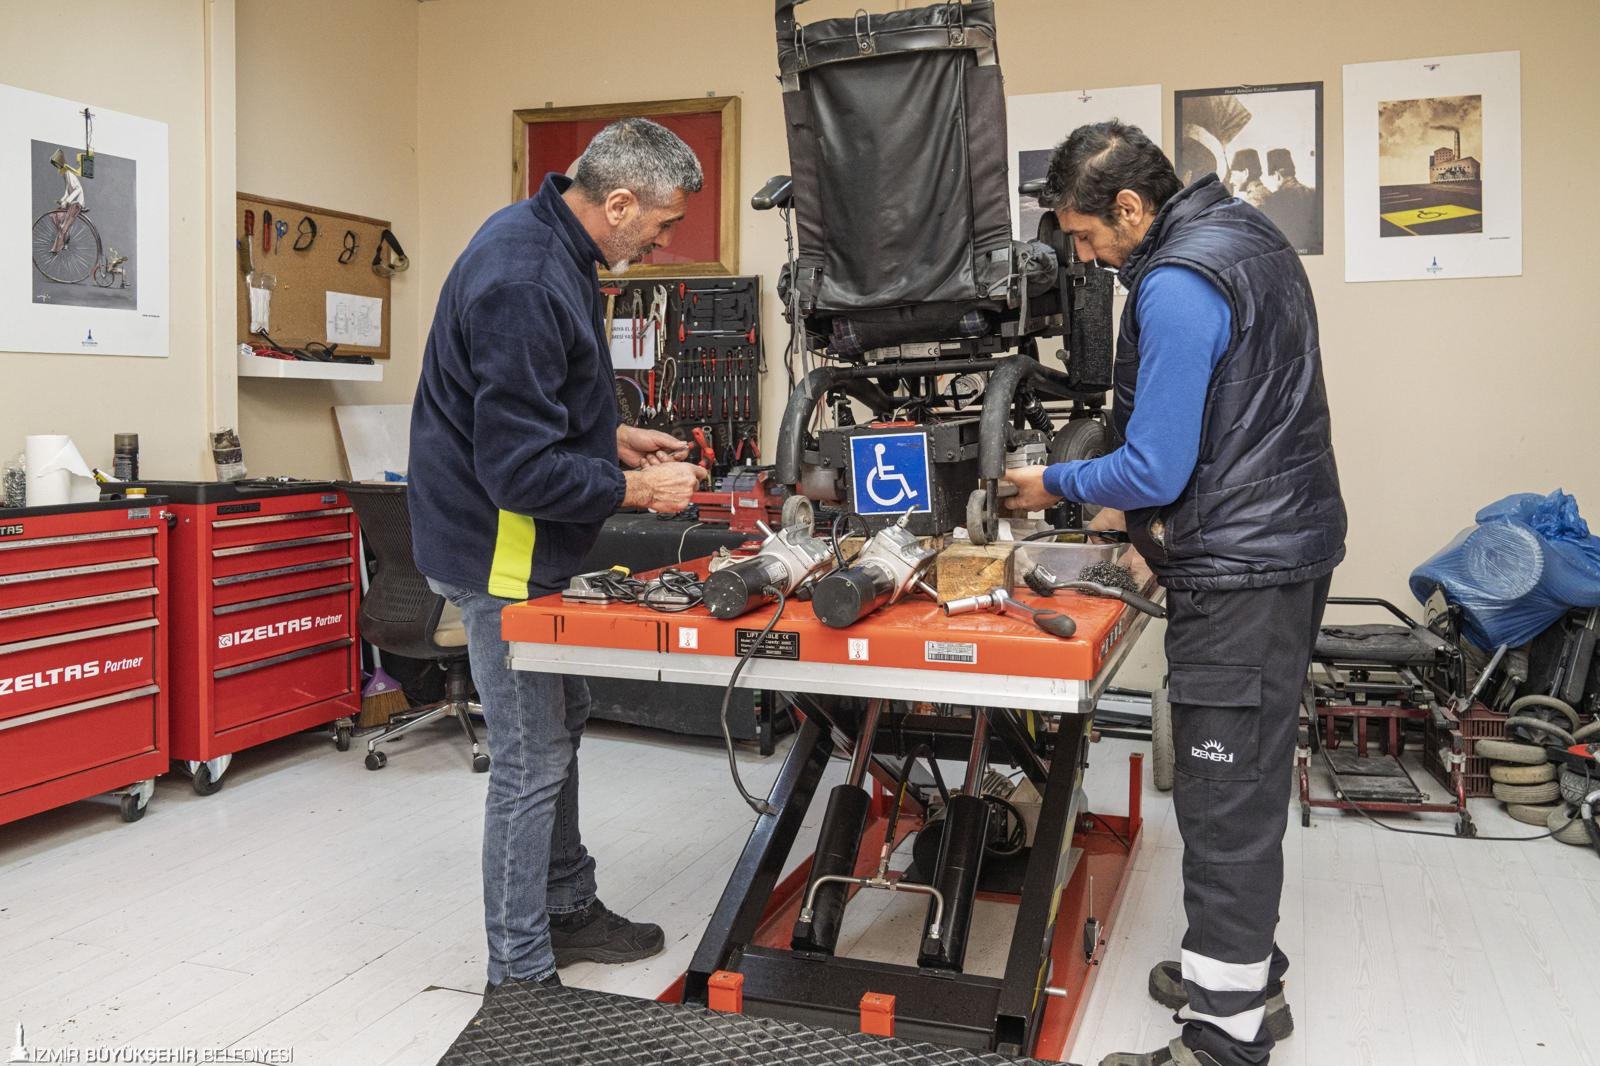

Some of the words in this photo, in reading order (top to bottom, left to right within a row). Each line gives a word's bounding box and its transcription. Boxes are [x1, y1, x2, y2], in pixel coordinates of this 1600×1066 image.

[0, 525, 24, 535] TAS
[314, 614, 342, 627] Partner
[0, 660, 100, 696] ZELTAS
[103, 656, 143, 674] Partner
